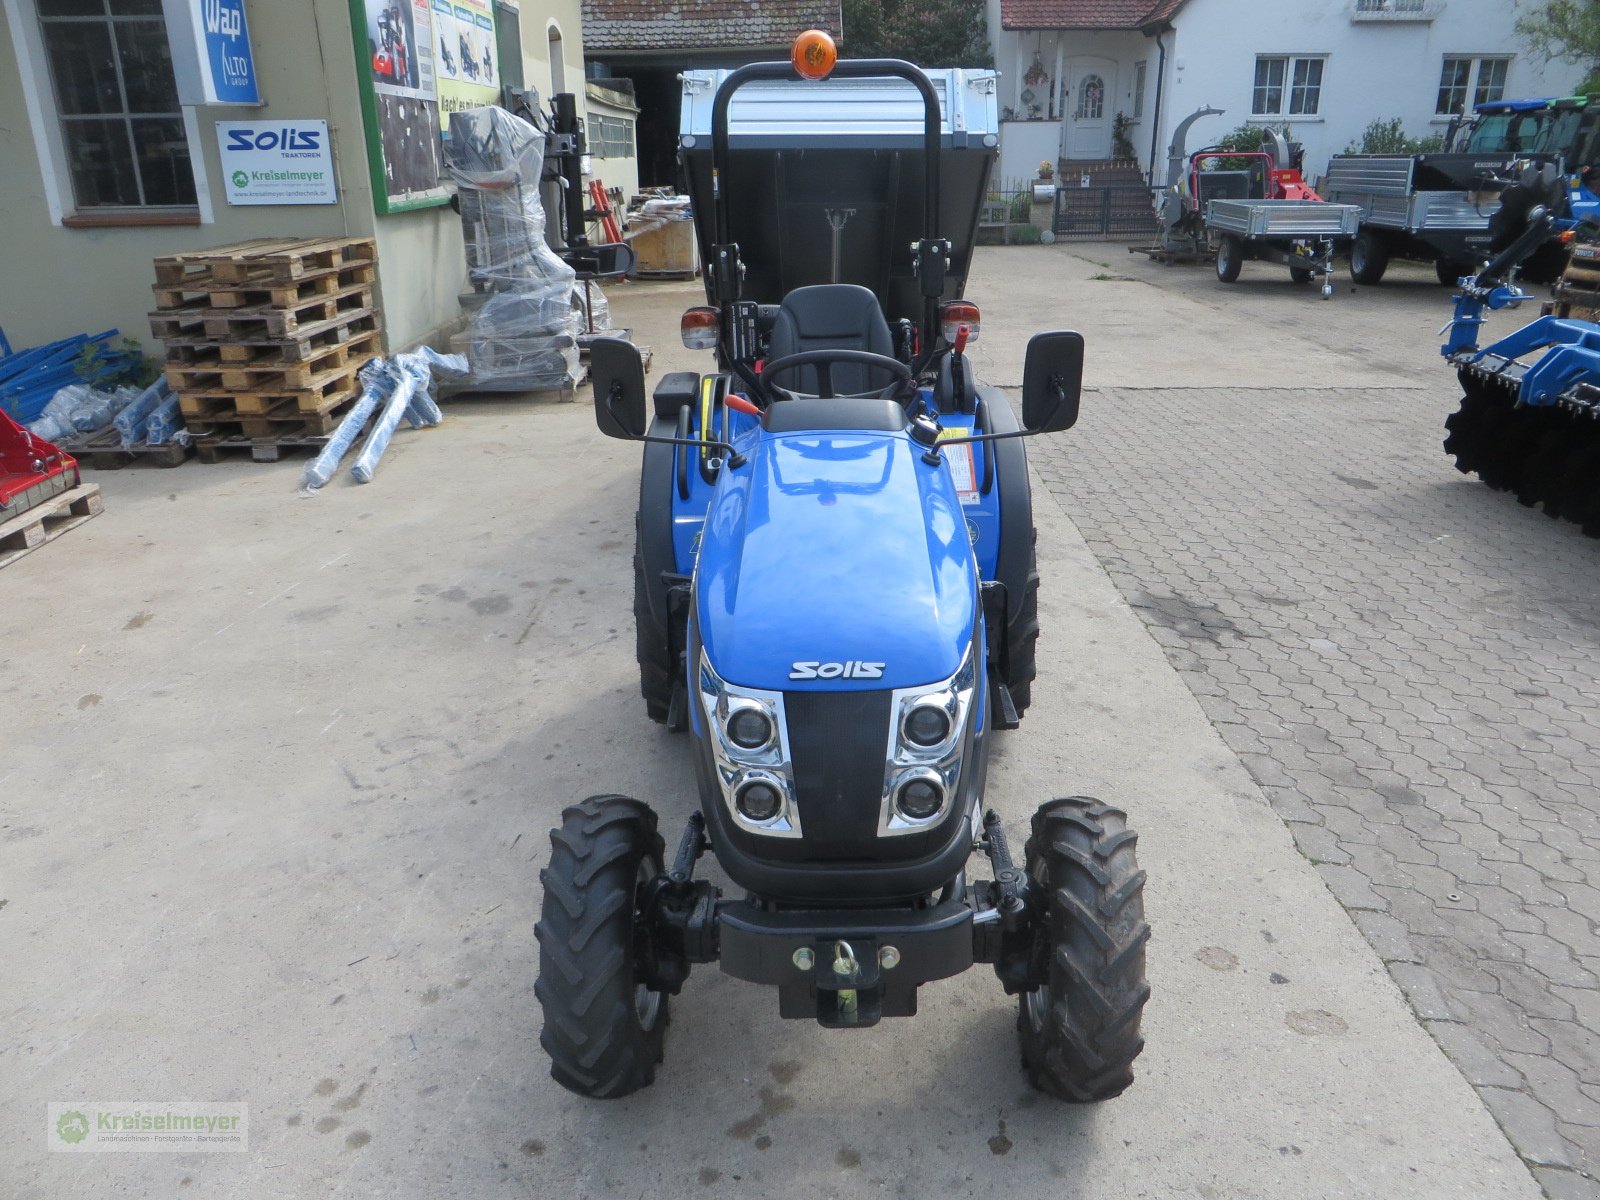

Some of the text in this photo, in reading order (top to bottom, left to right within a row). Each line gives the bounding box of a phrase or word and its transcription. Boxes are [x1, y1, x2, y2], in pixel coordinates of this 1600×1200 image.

[205, 0, 241, 42] Wap
[227, 128, 320, 151] Solis
[252, 170, 324, 181] Kreiselmeyer
